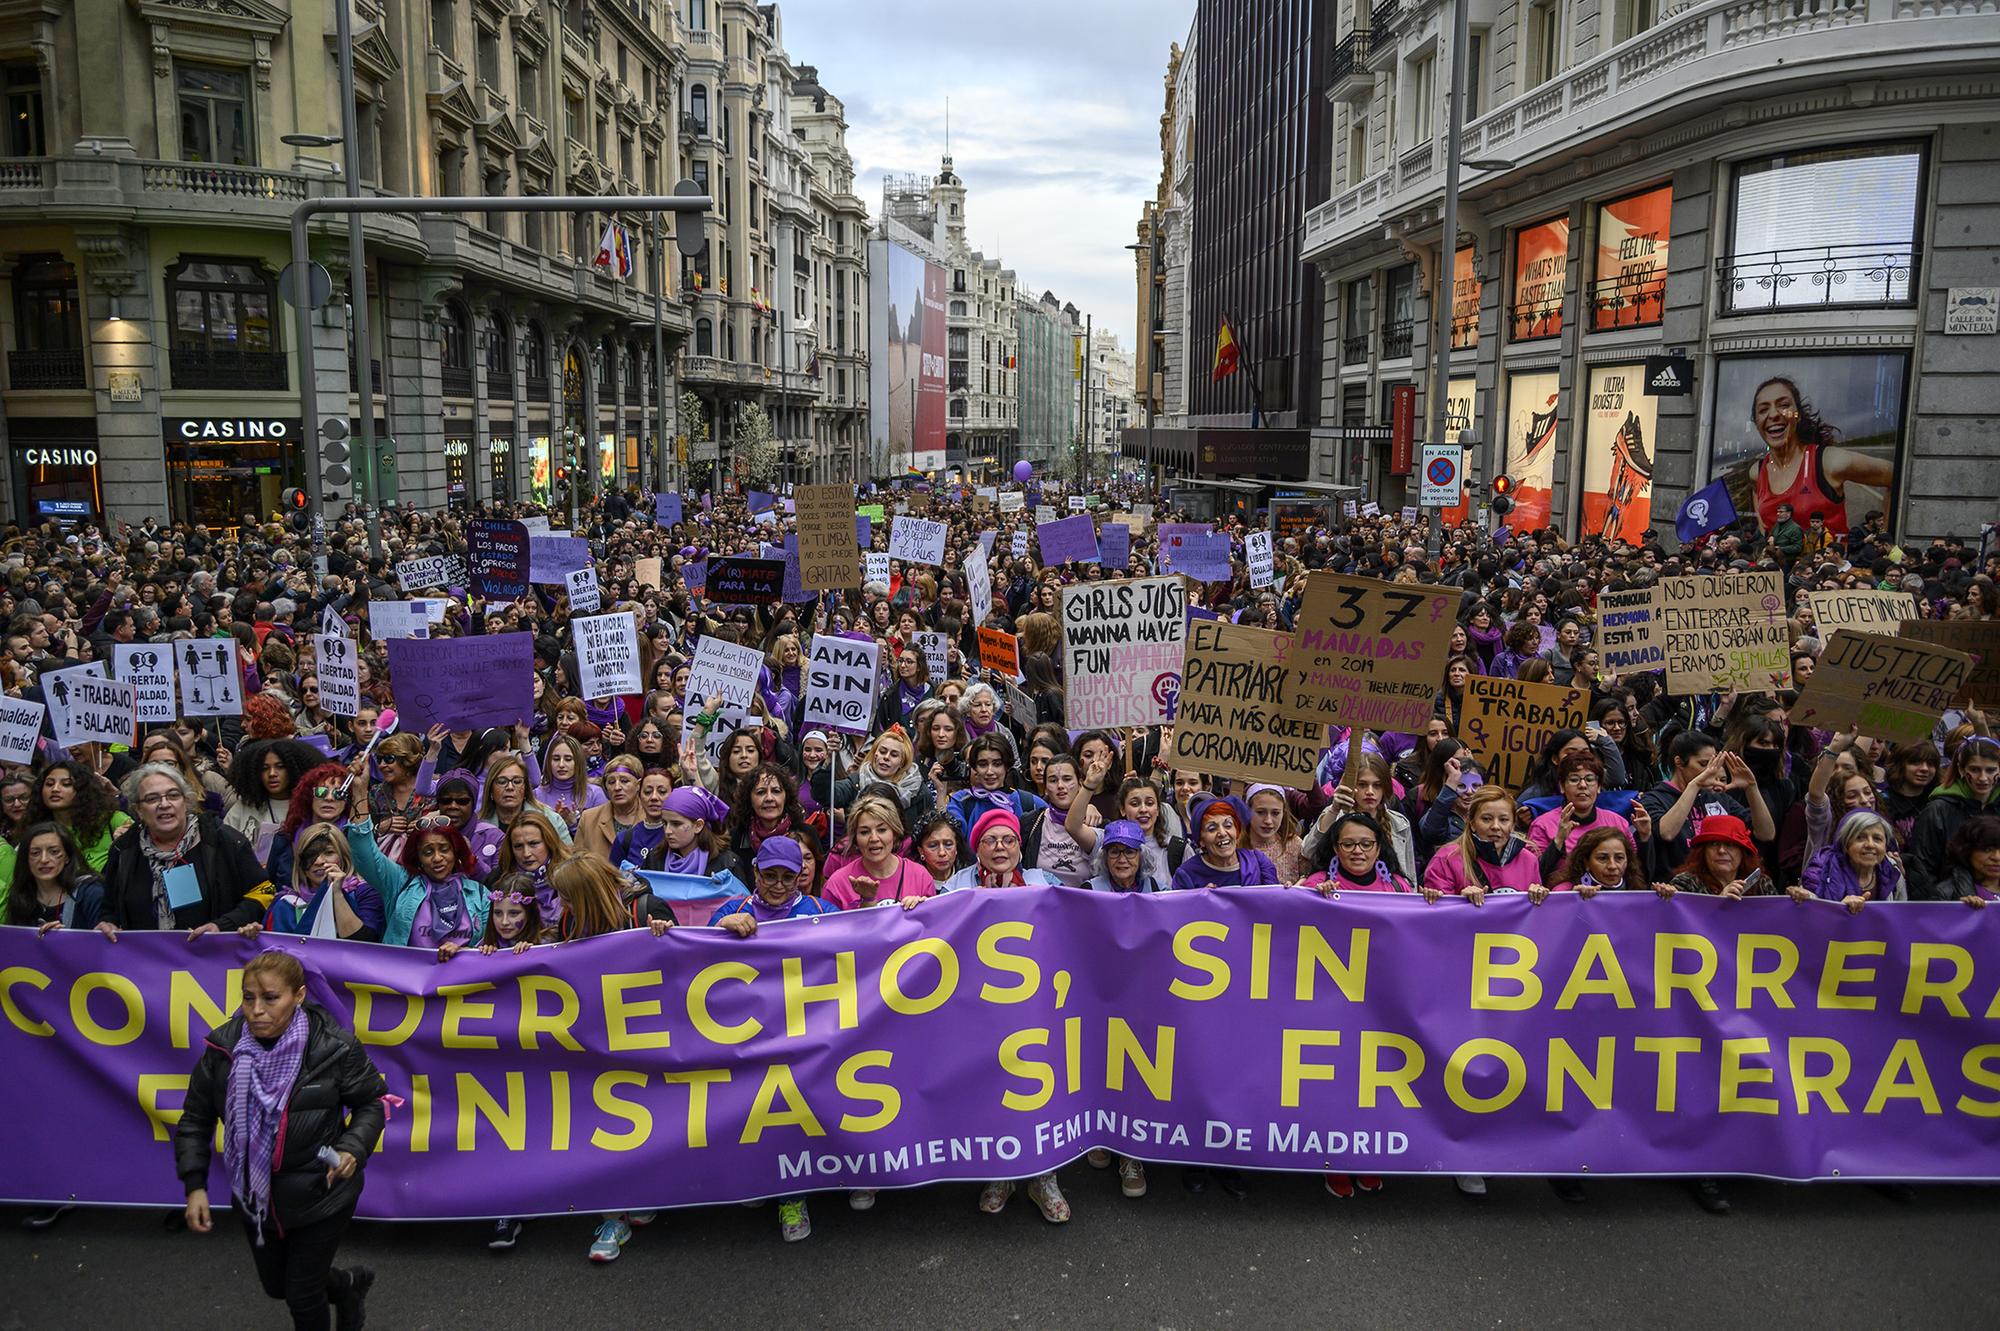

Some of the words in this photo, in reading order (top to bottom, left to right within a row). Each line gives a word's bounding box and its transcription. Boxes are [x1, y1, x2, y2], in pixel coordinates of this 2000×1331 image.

[1619, 236, 1639, 261] FEEL
[1640, 231, 1658, 256] THE
[1525, 258, 1552, 281] WHAT'S
[1620, 260, 1657, 286] ENERGY
[1521, 284, 1546, 304] FASTER
[1949, 323, 1994, 332] MONTERA
[1603, 376, 1625, 392] ULTRA
[1651, 379, 1681, 387] adidas
[1592, 394, 1615, 409] BOOST
[181, 421, 286, 438] CASINO
[26, 449, 97, 465] CASINO
[797, 488, 814, 500] NO
[484, 522, 513, 530] CHILE
[826, 522, 848, 530] DESDE
[477, 541, 492, 550] LOS
[495, 542, 519, 553] PACOS
[811, 531, 852, 546] TUMBA
[817, 551, 826, 559] SE
[911, 549, 936, 561] CALLAS
[416, 560, 431, 571] LAS
[807, 565, 851, 584] GRITAR
[1251, 564, 1272, 576] IGUAL
[481, 580, 525, 595] VIOLADOR
[718, 581, 745, 591] PARA
[753, 582, 772, 593] LA
[1252, 576, 1272, 588] AMIS
[1664, 580, 1695, 602] NOS
[1702, 575, 1776, 599] QUISIERON
[1065, 586, 1133, 622] GIRLS
[1138, 582, 1184, 619] JUST
[1600, 591, 1651, 608] TRANQUILA
[1814, 595, 1919, 625] ECOFEMINISMO
[582, 620, 592, 635] NO
[593, 619, 601, 631] ES
[602, 616, 628, 631] MORAL,
[1066, 622, 1131, 646] WANNA
[1137, 619, 1182, 643] HAVE
[586, 636, 595, 649] NI
[596, 633, 603, 646] ES
[1195, 625, 1229, 652] EL
[1302, 628, 1425, 661] MANADAS
[1603, 626, 1634, 645] ESTÁ
[1637, 628, 1649, 641] TU
[1666, 634, 1700, 652] PERO
[1703, 630, 1720, 650] NO
[1767, 626, 1788, 645] QUE
[587, 651, 595, 664] EL
[596, 646, 630, 663] MALTRATO
[700, 640, 737, 660] luchar
[738, 650, 762, 669] HOY
[813, 646, 872, 669] AMA
[925, 653, 946, 663] RTAD,
[1669, 653, 1726, 673] ÉRAMOS
[1729, 647, 1789, 672] SEMILLAS
[1828, 635, 1967, 689] JUSTICIA
[320, 663, 356, 682] LIBERTAD,
[593, 661, 627, 678] SOPORTAR.
[695, 659, 715, 671] para
[717, 663, 729, 674] NO
[729, 665, 753, 681] MORIR
[928, 665, 946, 675] LDAD,
[1314, 656, 1331, 666] en
[1341, 656, 1374, 673] 2019
[320, 680, 357, 700] IGUALDAD,
[687, 673, 751, 705] MAÑANA
[810, 671, 871, 694] SIN
[1073, 672, 1136, 696] HUMAN
[1310, 670, 1362, 692] MANOLO
[1366, 680, 1399, 695] TIENE
[1400, 682, 1434, 699] MIEDO
[1470, 679, 1528, 700] IGUAL
[82, 684, 134, 713] TRABAJO,
[136, 690, 170, 702] UALDAD,
[1295, 694, 1314, 709] DE
[1318, 696, 1338, 712] LAS
[137, 706, 171, 715] ISTAD.
[808, 696, 867, 722] AM@.
[1070, 694, 1154, 727] RIGHTS!
[1479, 698, 1583, 729] TRABAJO
[83, 712, 133, 737] SALARIO.
[686, 716, 742, 733] SN
[1180, 700, 1223, 727] MATA
[1230, 705, 1265, 732] MÁS
[1268, 714, 1301, 738] QUE
[1303, 722, 1321, 740] EL
[1, 732, 11, 748] ni
[10, 732, 35, 752] más!
[1177, 731, 1316, 774] CORONAVIRUS
[344, 920, 1072, 1052] DERECHOS,
[1167, 920, 1372, 1003] SIN
[1469, 931, 2000, 1019] BARRERA
[137, 1049, 902, 1153] FINISTAS
[997, 1016, 1177, 1112] SIN
[1280, 1028, 2000, 1117] FRONTERAS
